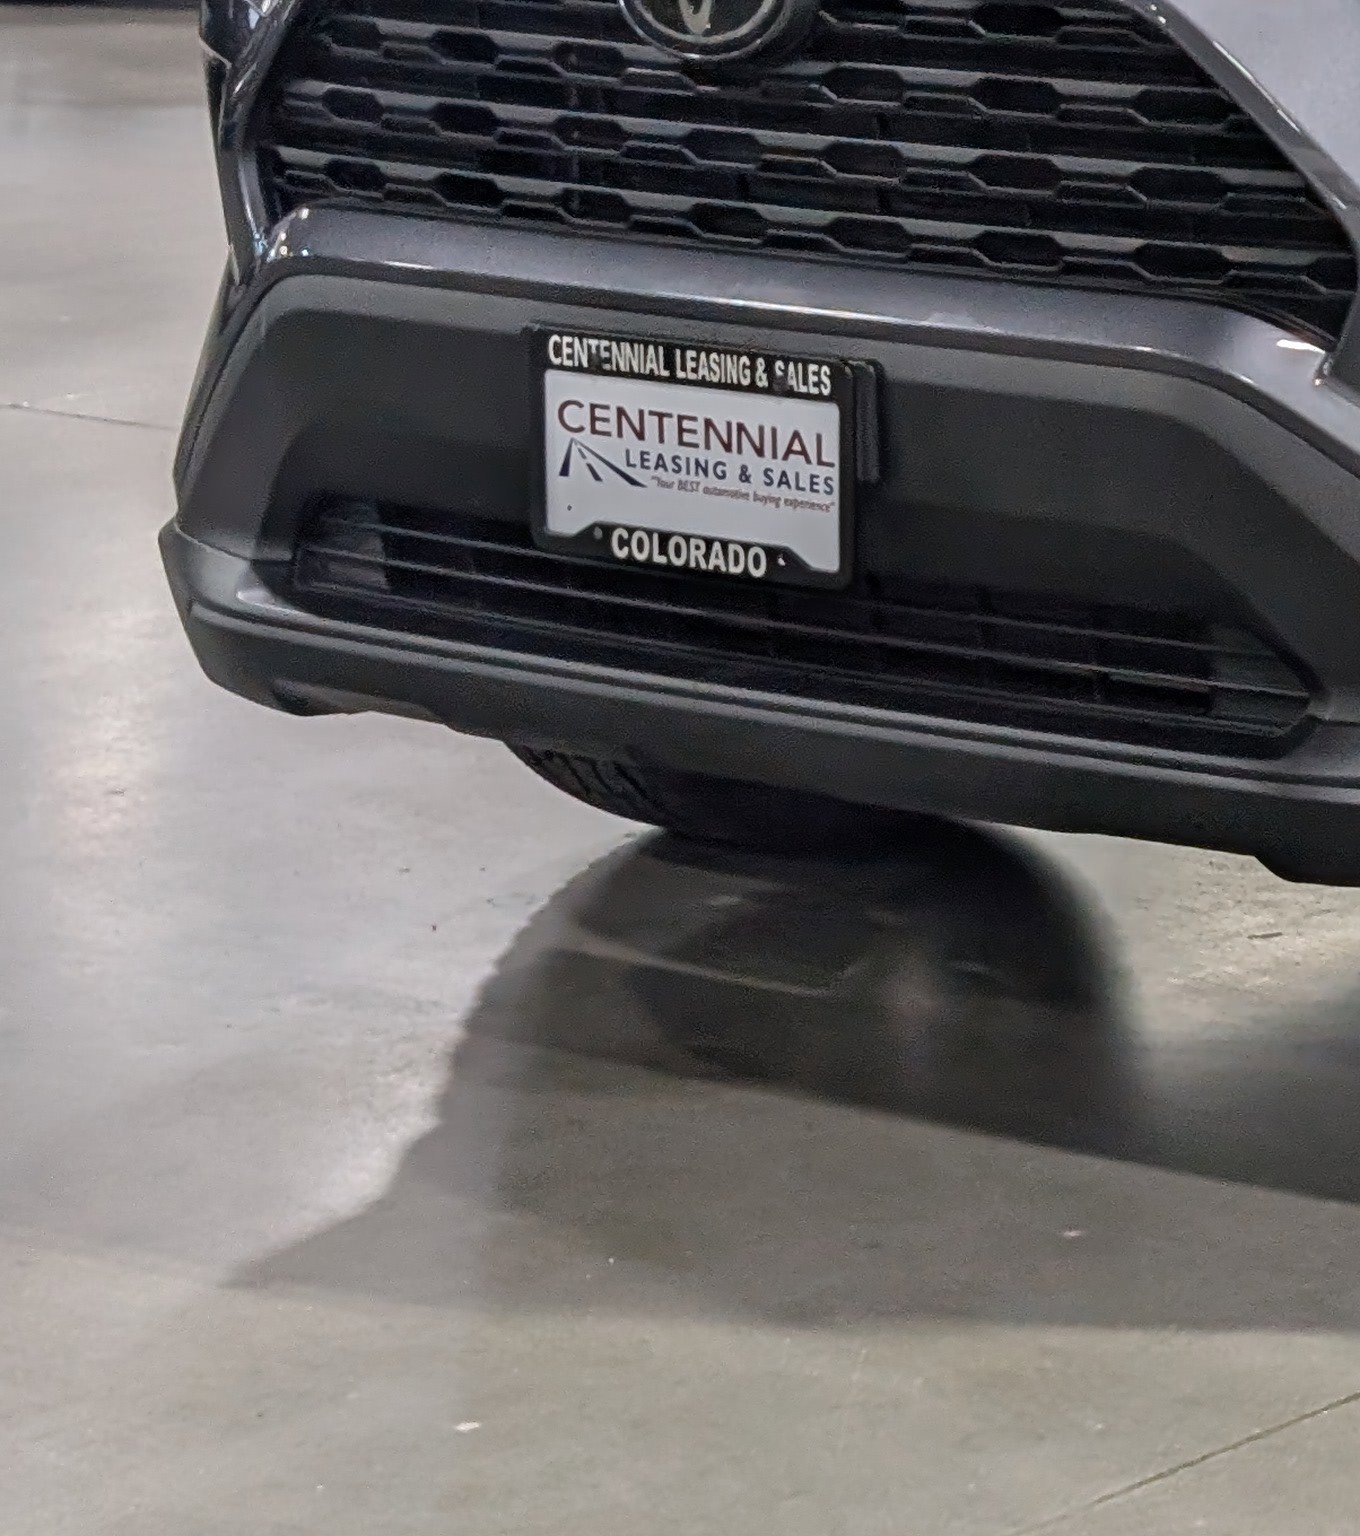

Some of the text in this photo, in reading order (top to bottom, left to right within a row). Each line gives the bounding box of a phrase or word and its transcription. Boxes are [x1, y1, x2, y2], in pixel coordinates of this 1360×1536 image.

[675, 348, 751, 387] LEASING
[755, 357, 769, 388] &
[557, 399, 836, 468] CENTENNIAL
[625, 449, 835, 496] LEASING & SALES
[611, 527, 767, 578] COLORADO
